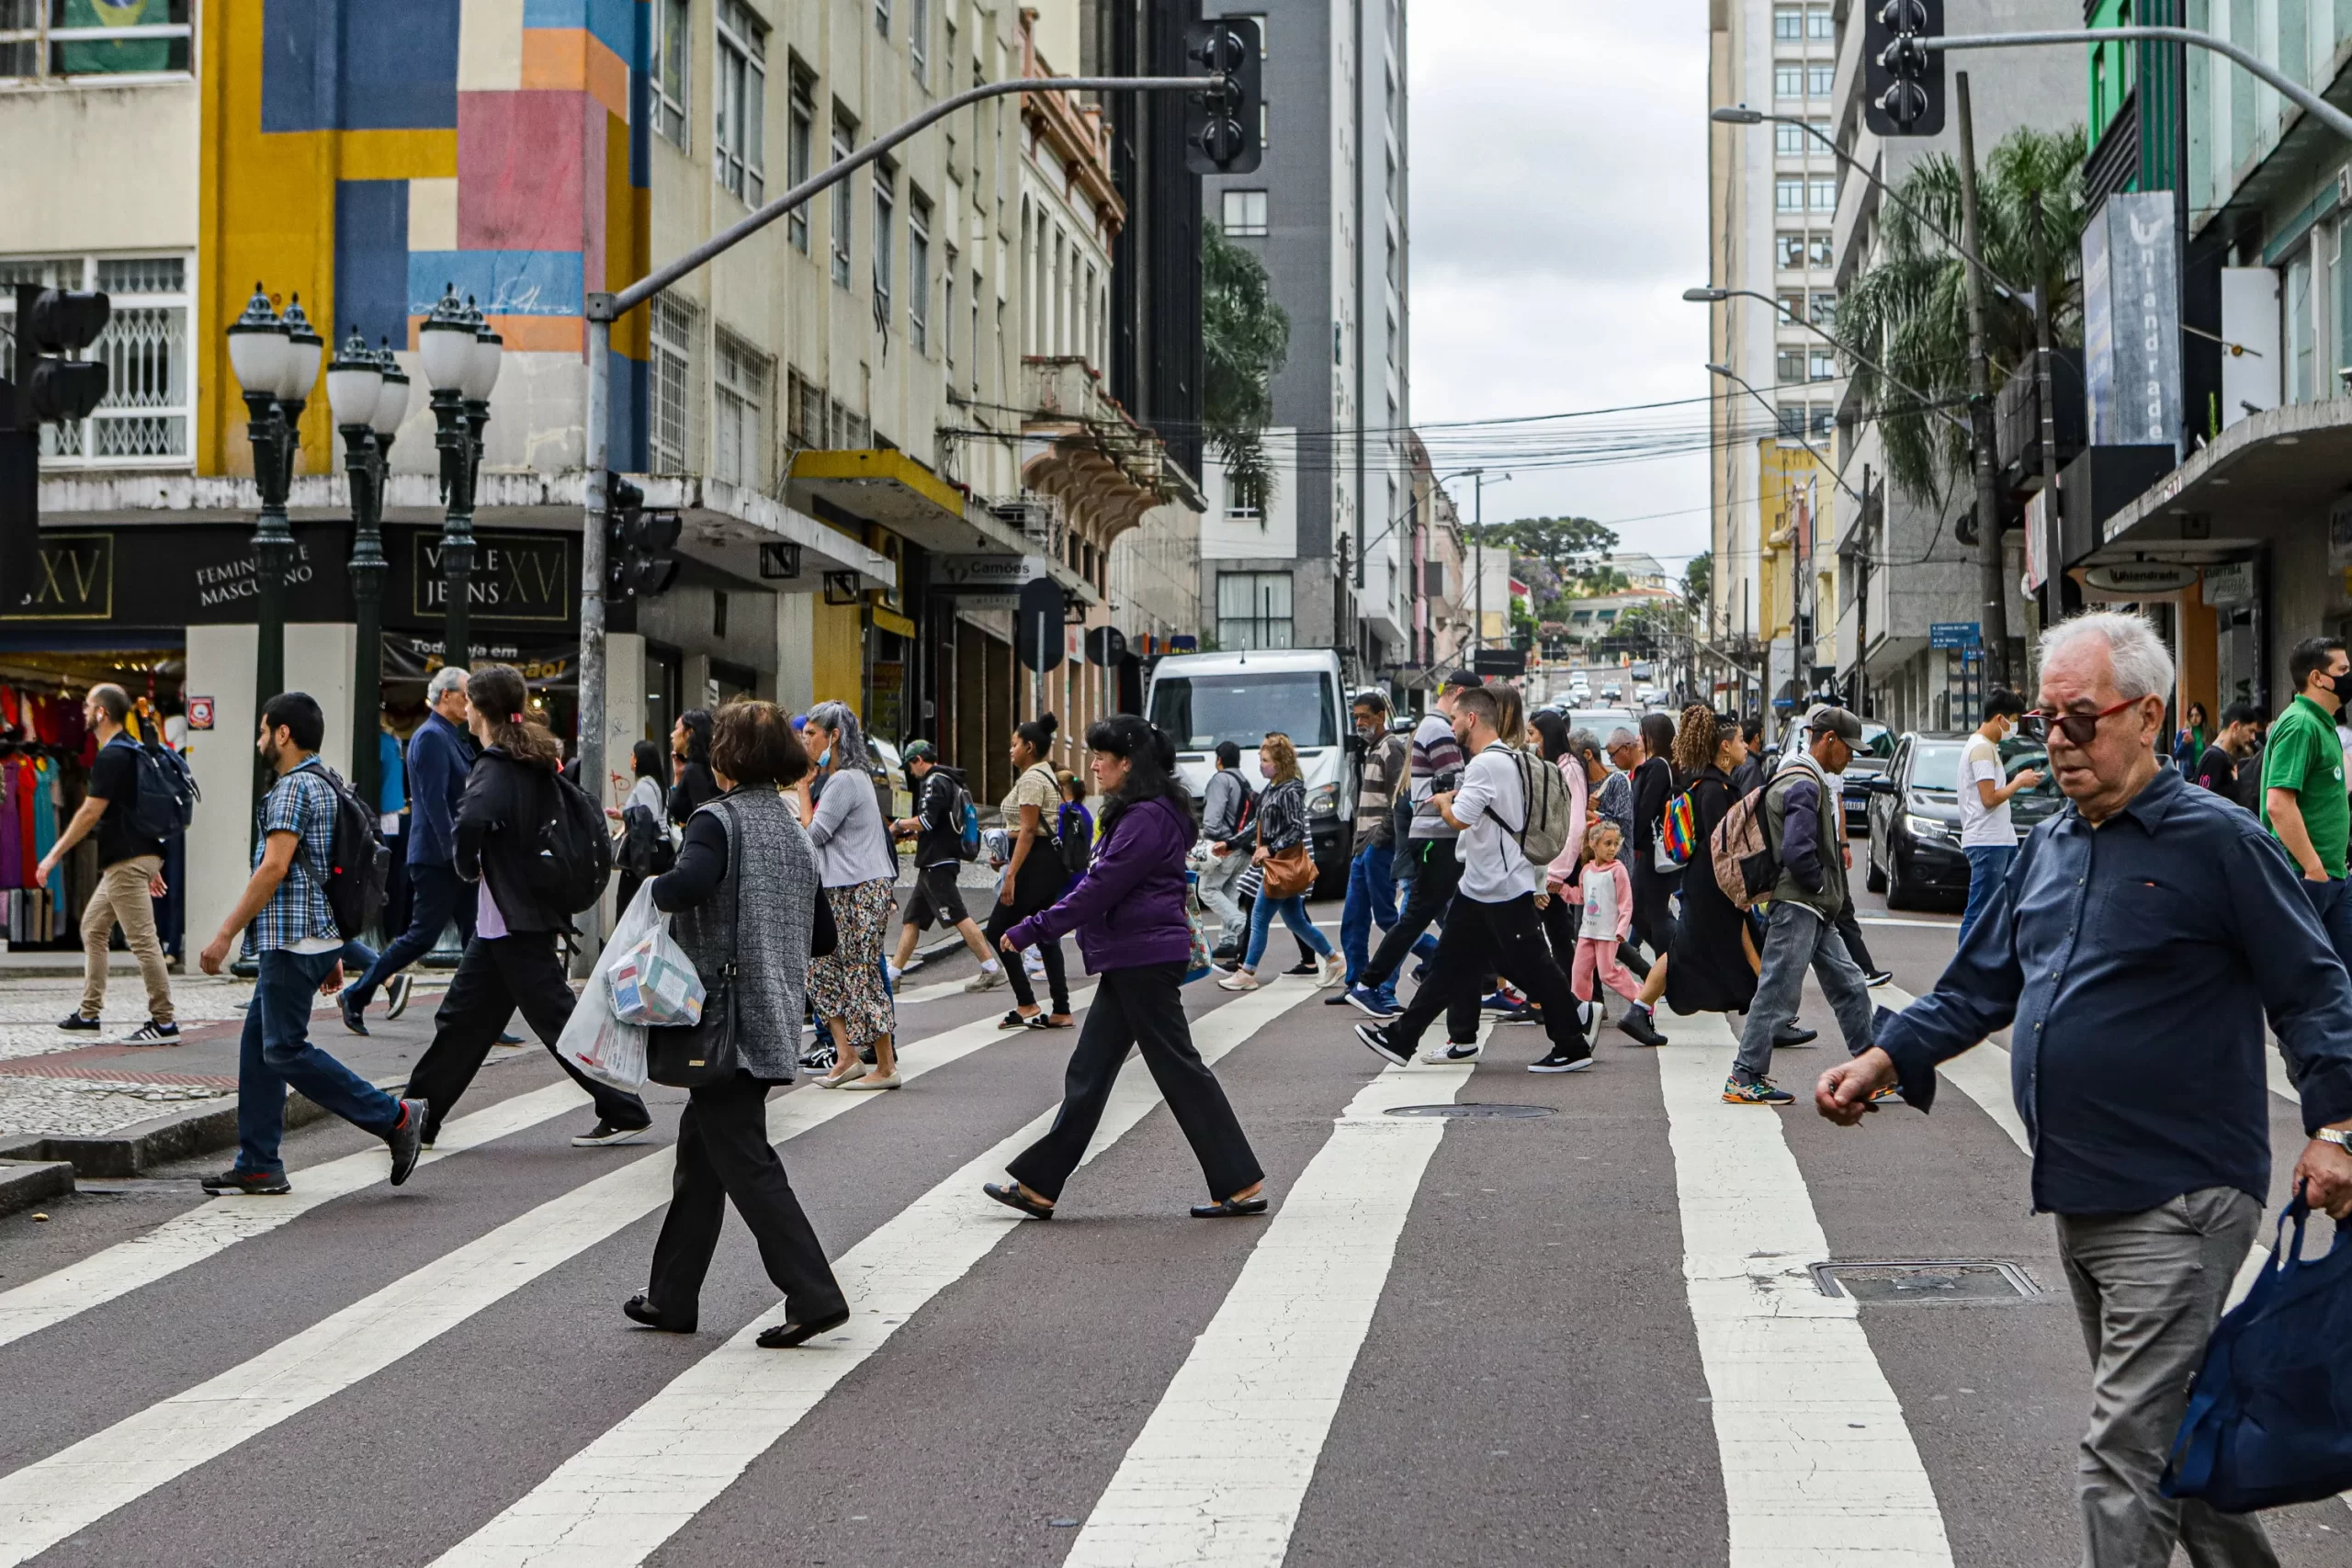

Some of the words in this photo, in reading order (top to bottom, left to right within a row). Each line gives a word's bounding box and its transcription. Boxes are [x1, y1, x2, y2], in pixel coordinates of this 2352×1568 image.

[425, 547, 499, 570] VLE
[971, 561, 1030, 574] Camões
[37, 549, 100, 603] XV
[201, 566, 312, 606] MASCNO
[504, 551, 560, 603] XV
[426, 581, 499, 606] JENS
[491, 647, 518, 659] em
